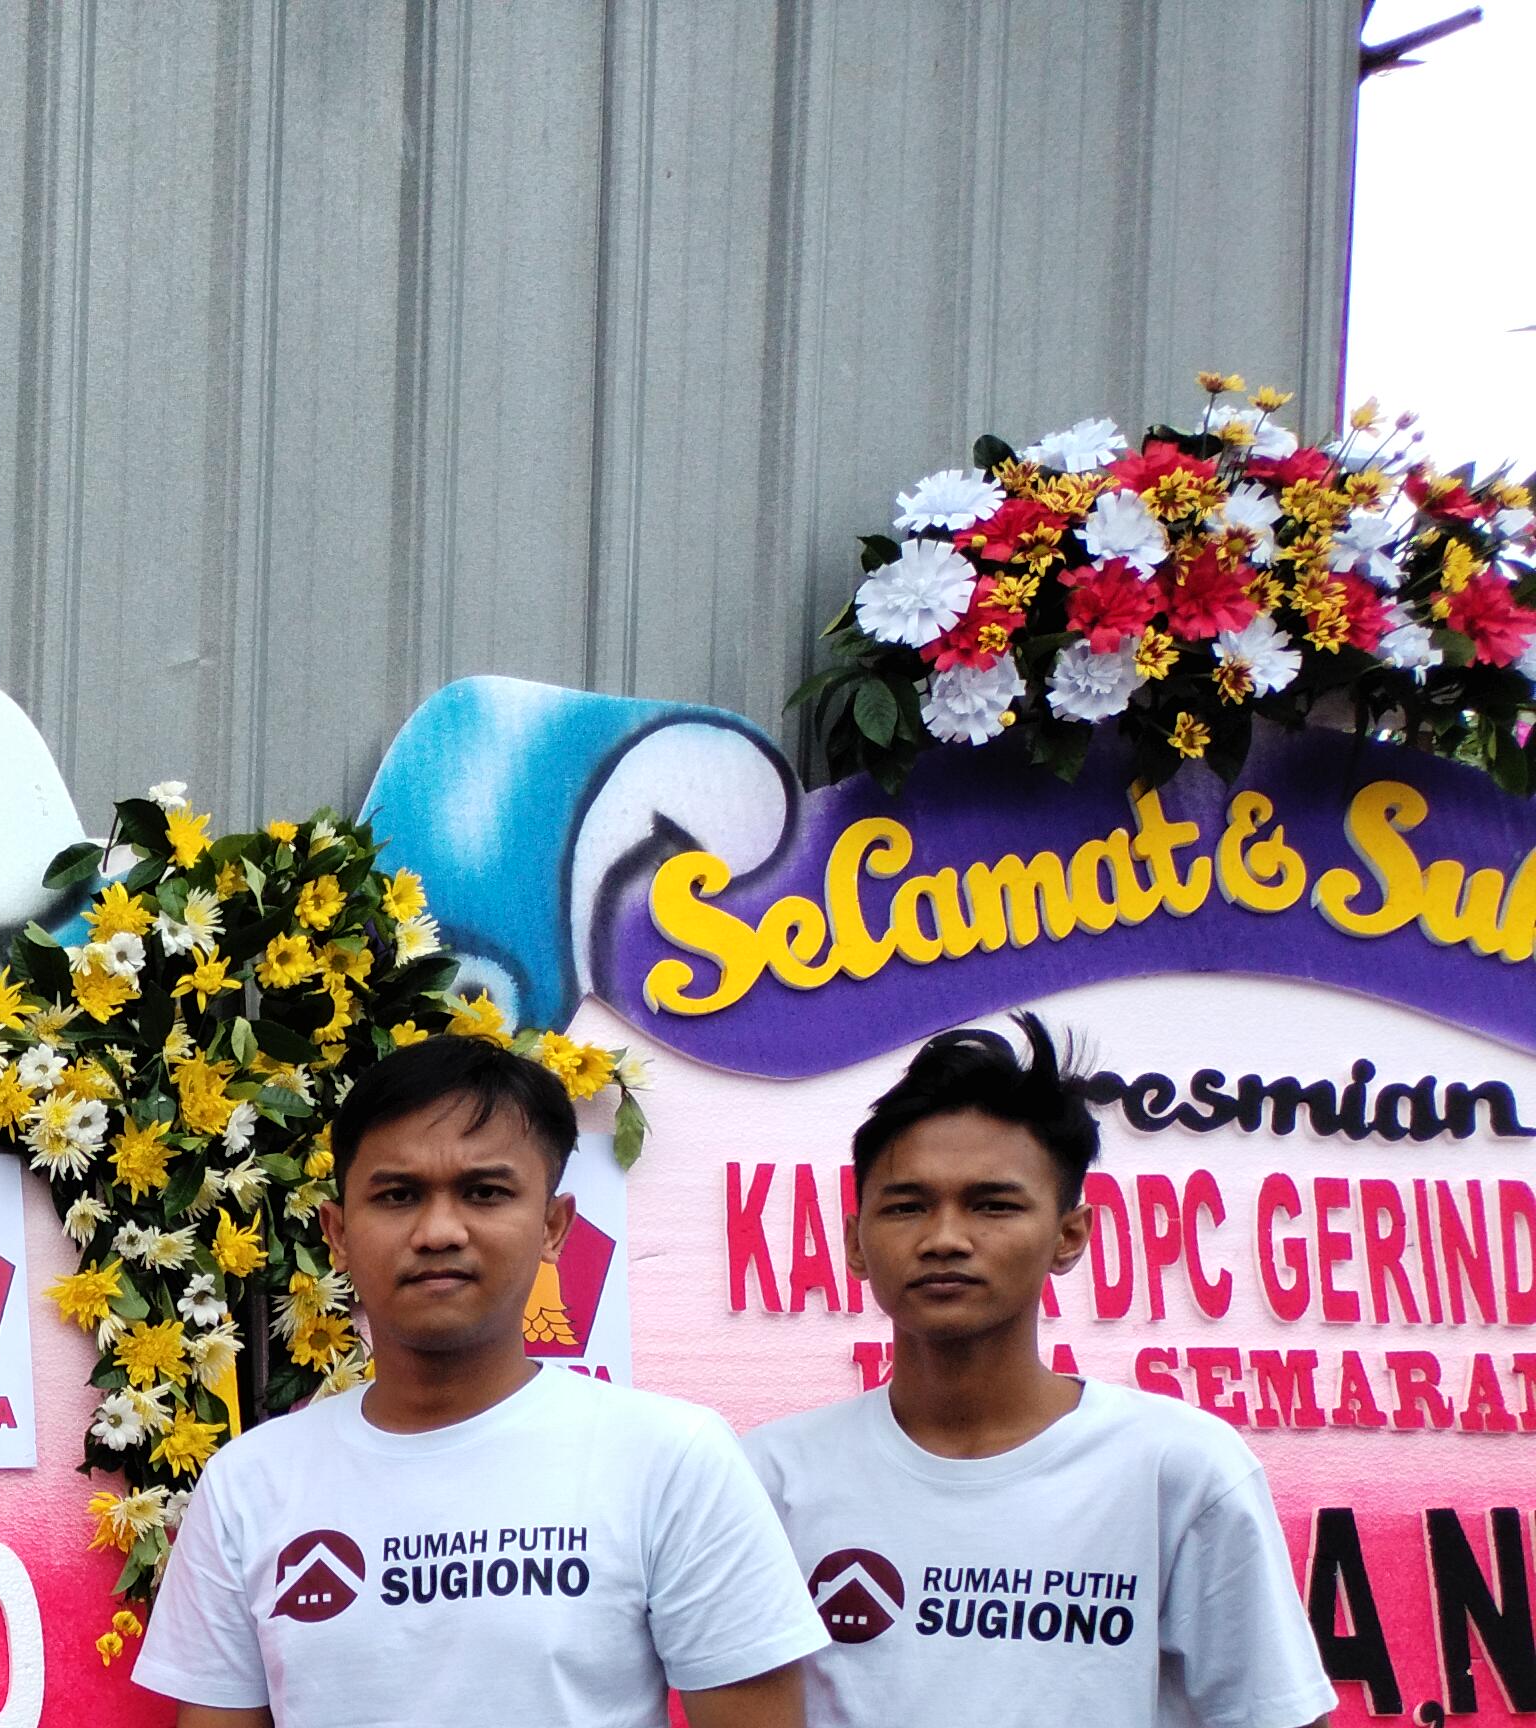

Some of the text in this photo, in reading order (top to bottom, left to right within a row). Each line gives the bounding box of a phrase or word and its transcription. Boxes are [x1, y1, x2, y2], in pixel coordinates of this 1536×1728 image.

[644, 780, 1212, 1016] Selamat
[1216, 790, 1307, 914] &
[1084, 1169, 1233, 1321] DPC
[383, 1527, 588, 1562] RUMAH PUTIH
[381, 1557, 590, 1606] SUGIONO
[922, 1566, 1137, 1600] RUMAH PUTIH
[915, 1597, 1135, 1647] SUGIONO
